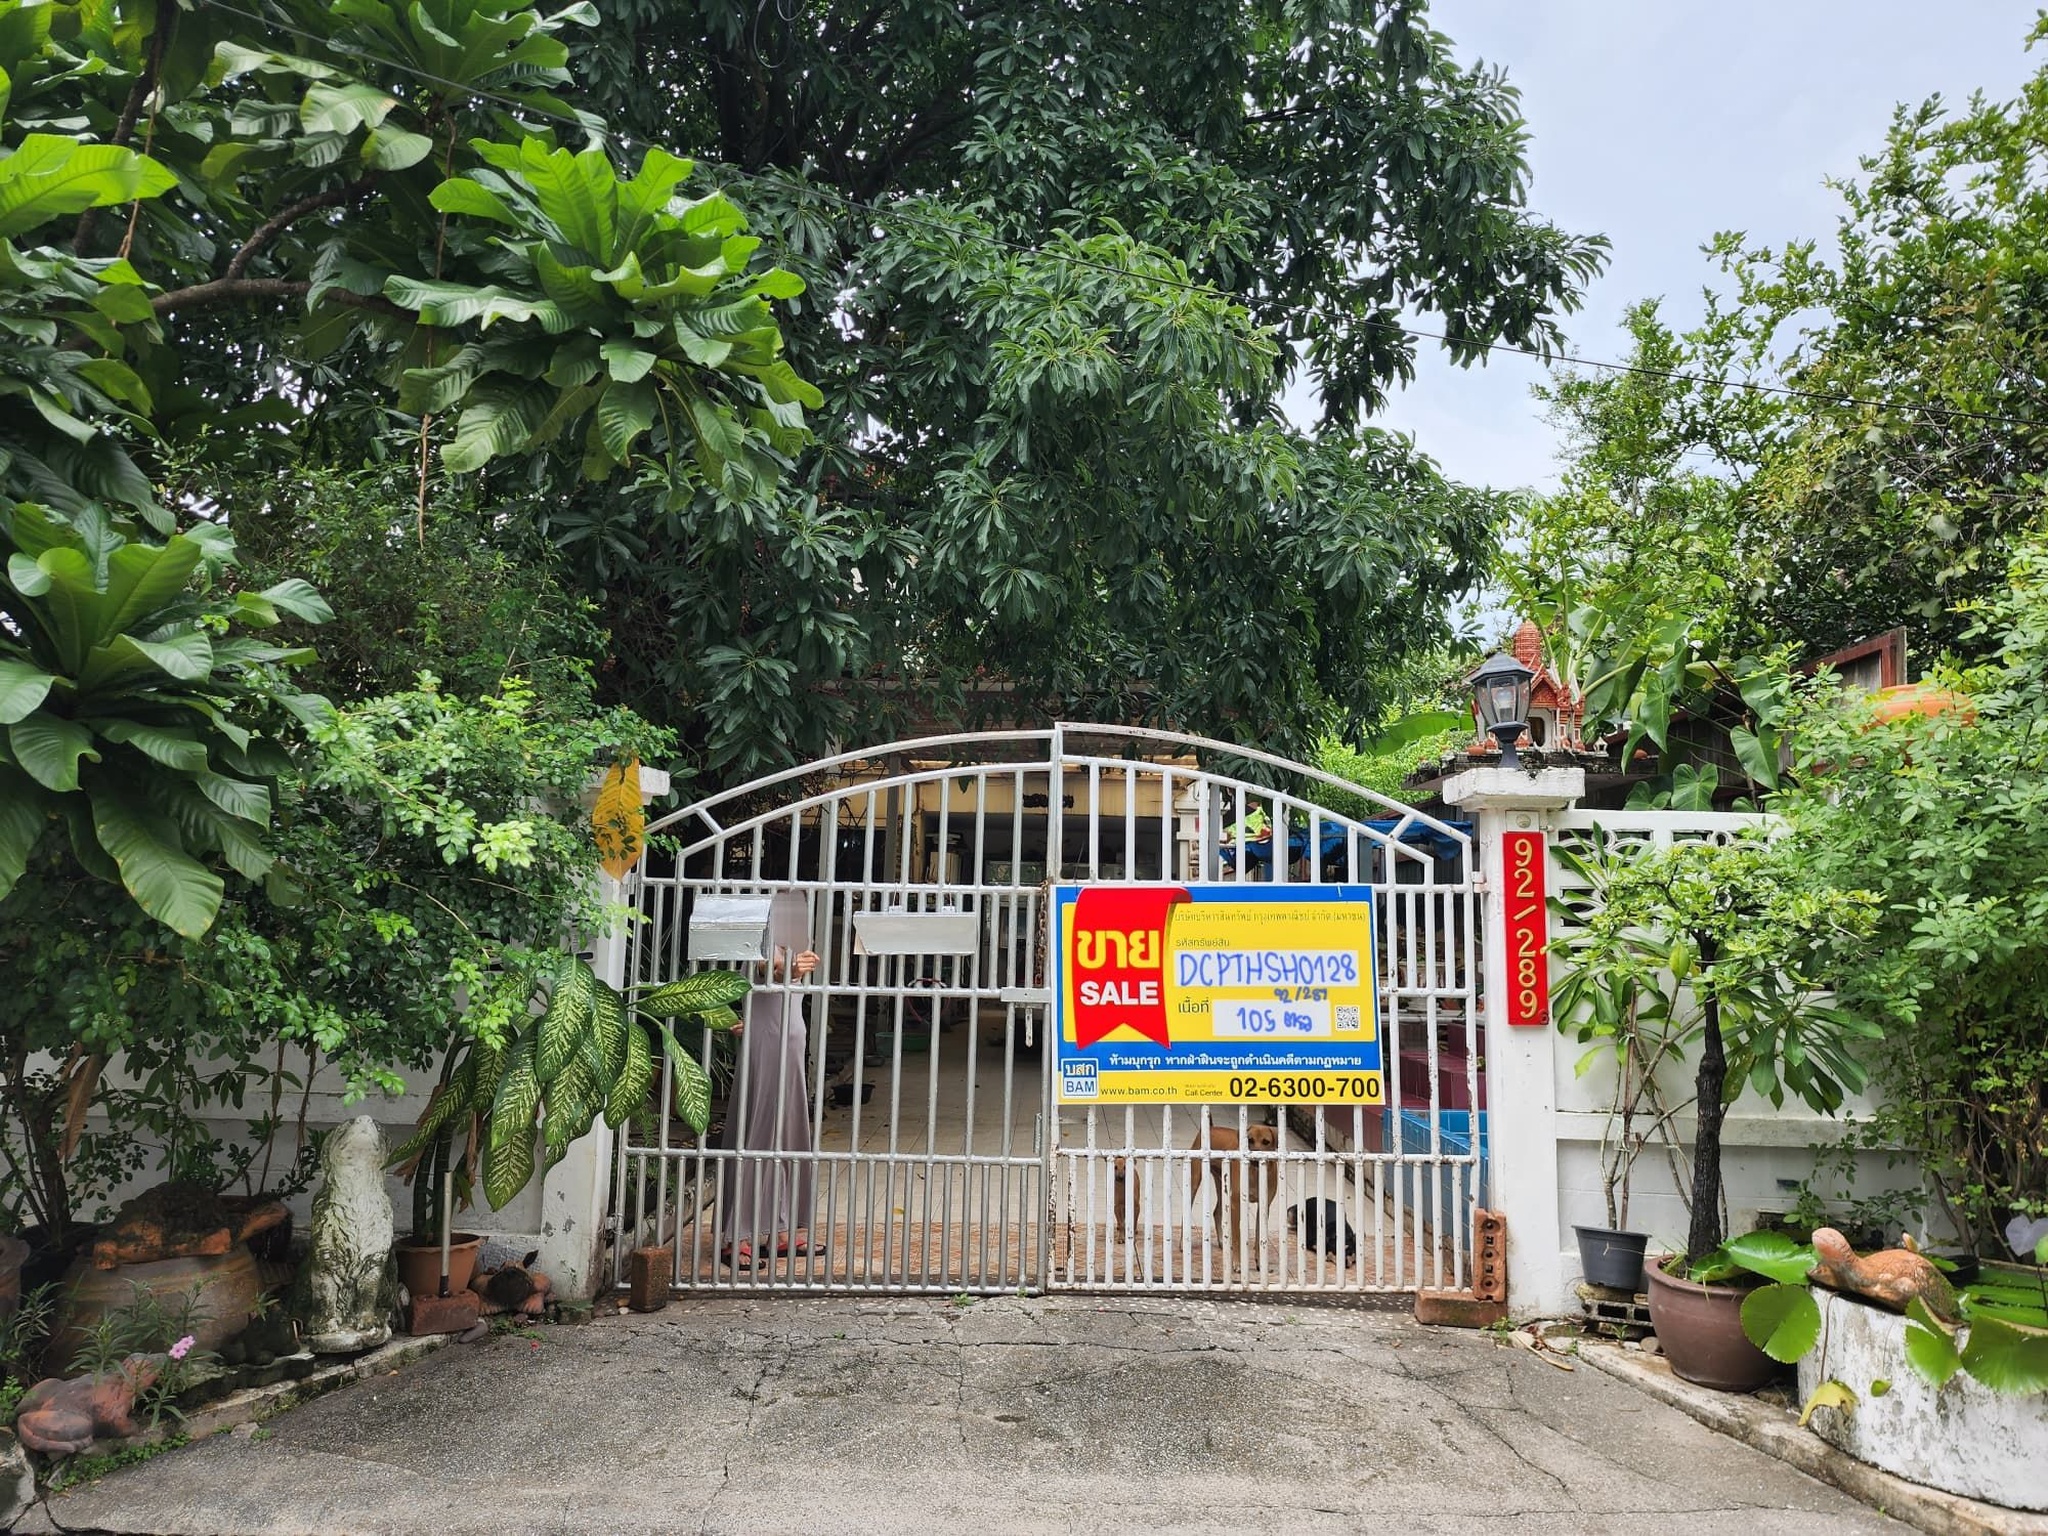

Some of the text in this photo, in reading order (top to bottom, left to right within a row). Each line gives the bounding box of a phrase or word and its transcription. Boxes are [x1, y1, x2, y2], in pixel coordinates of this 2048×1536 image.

[1513, 838, 1538, 1019] 92/289
[1077, 930, 1160, 969] ขาย
[1080, 980, 1159, 1006] SALE
[1178, 996, 1209, 1014] เนื้อที่
[1065, 1063, 1095, 1076] บสก
[1109, 1053, 1161, 1069] ห้ามบุกรุก
[1066, 1080, 1095, 1093] BAM
[1101, 1084, 1178, 1096] www.bam.co.th
[1229, 1077, 1380, 1098] 02-6300-700
